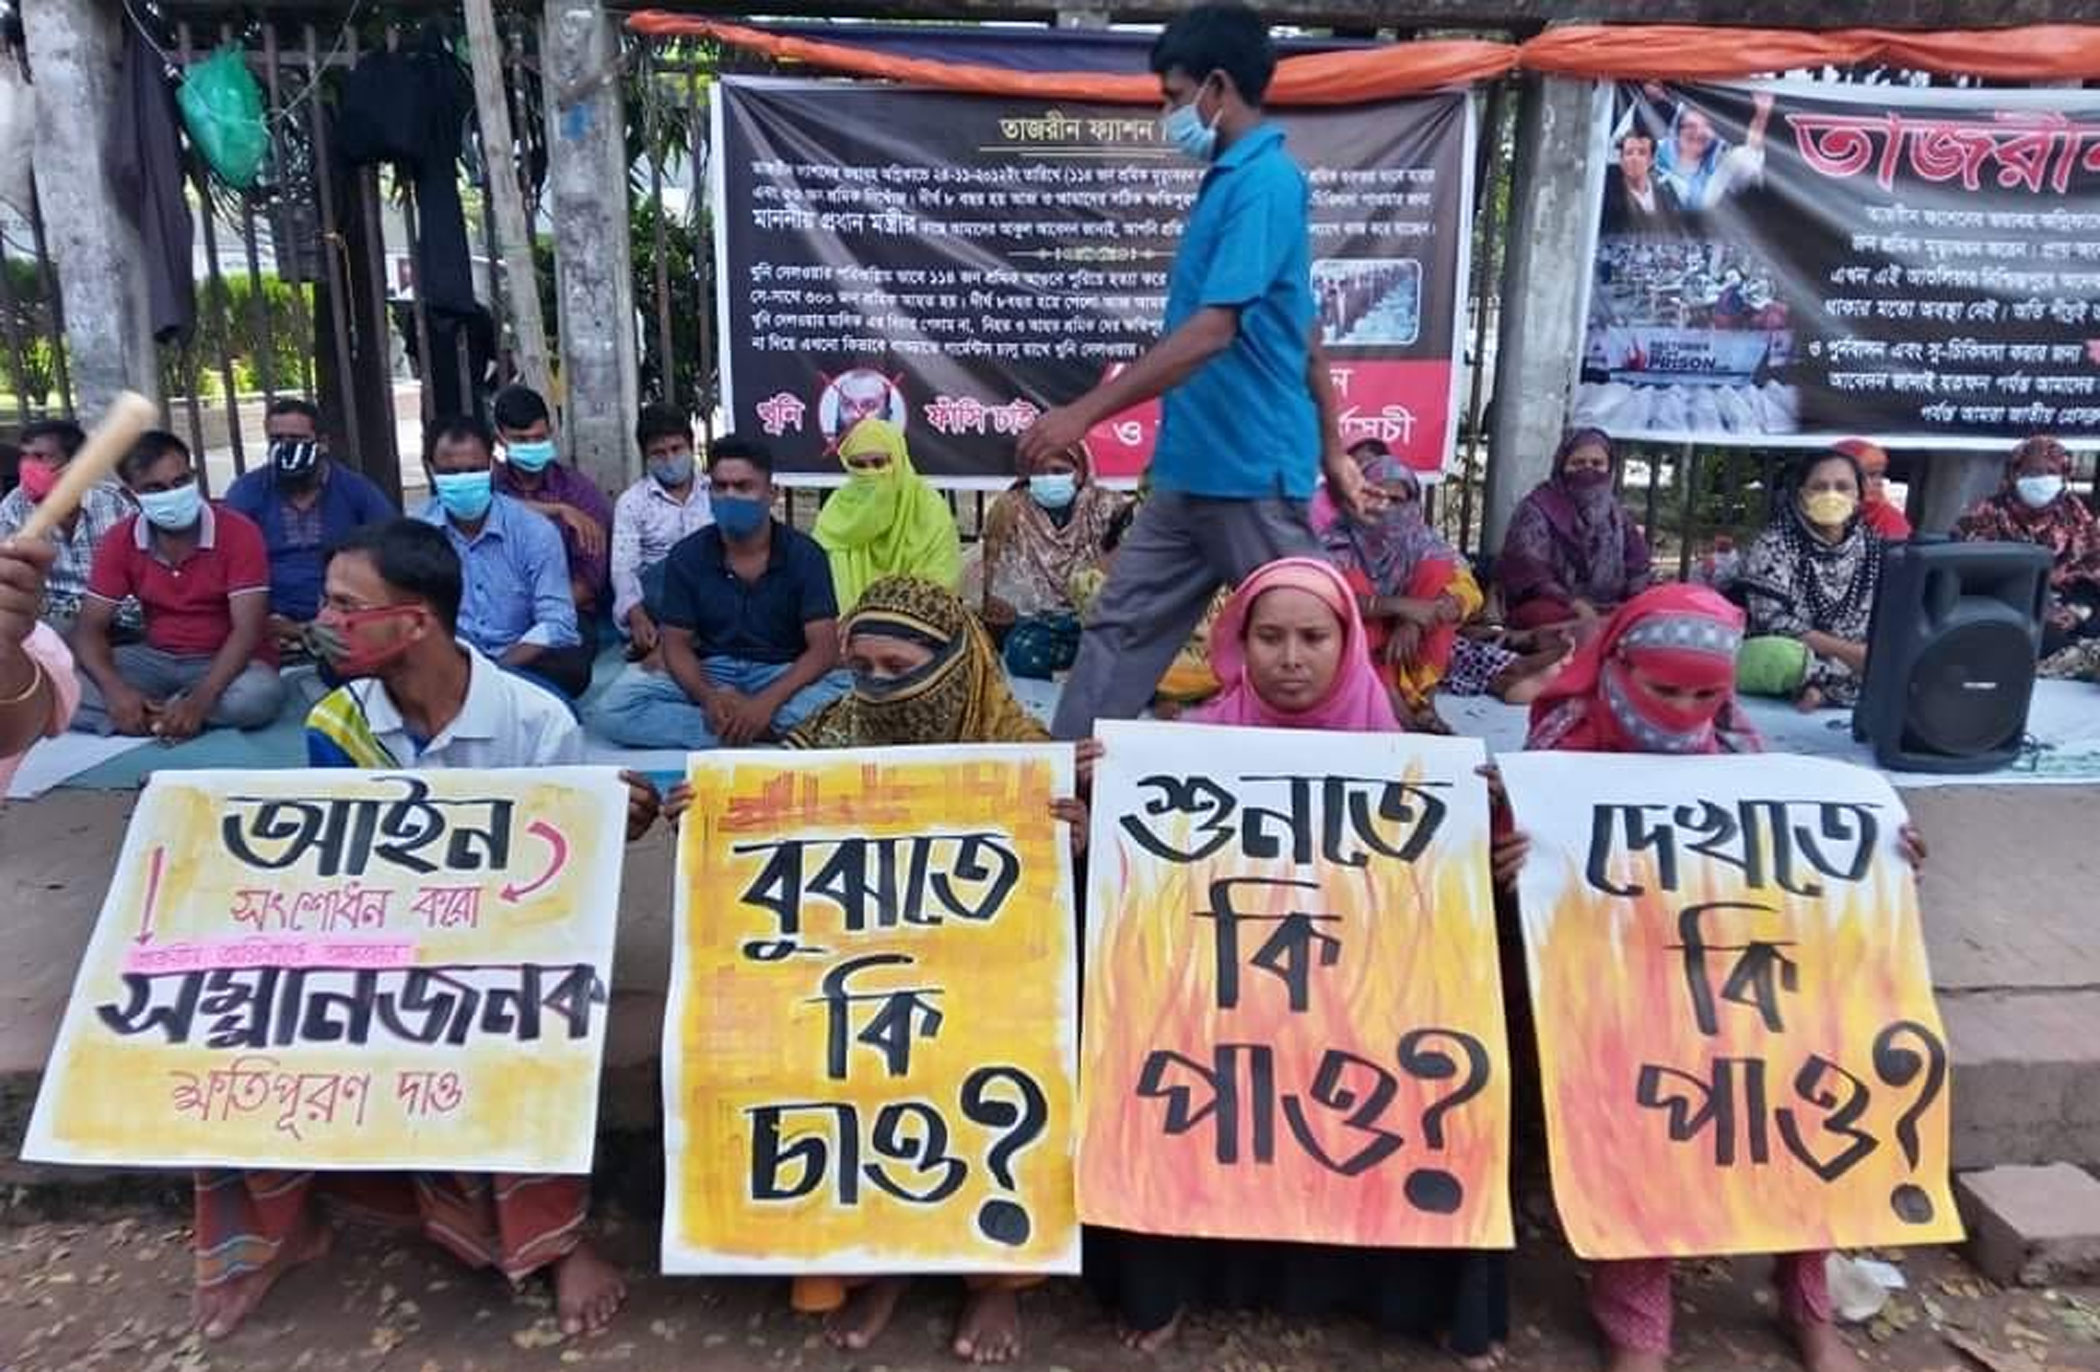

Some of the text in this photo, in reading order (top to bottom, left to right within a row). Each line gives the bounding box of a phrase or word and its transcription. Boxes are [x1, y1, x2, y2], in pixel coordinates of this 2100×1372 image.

[998, 109, 1156, 141] তাজরীন ফ্যাশন
[752, 203, 820, 229] মাননীয়
[821, 213, 864, 234] প্রধান
[1890, 341, 1923, 360] এবং
[757, 393, 806, 436] খুনি
[1113, 421, 1141, 446] ও
[222, 776, 514, 876] আইন
[1120, 774, 1456, 867] শুনতে
[1586, 798, 1884, 897] দেখতে
[230, 881, 482, 930] সংশোধন করো
[732, 832, 1021, 961] বুঝতে
[1193, 878, 1342, 1011] কি
[805, 954, 944, 1080] কি
[1663, 902, 1799, 1036] কি
[172, 1056, 462, 1140] ক্ষতিপূরণ দাও
[1136, 1028, 1491, 1212] পাও?
[1635, 1020, 1946, 1224] পাও?
[744, 1066, 1048, 1245] চাও?
